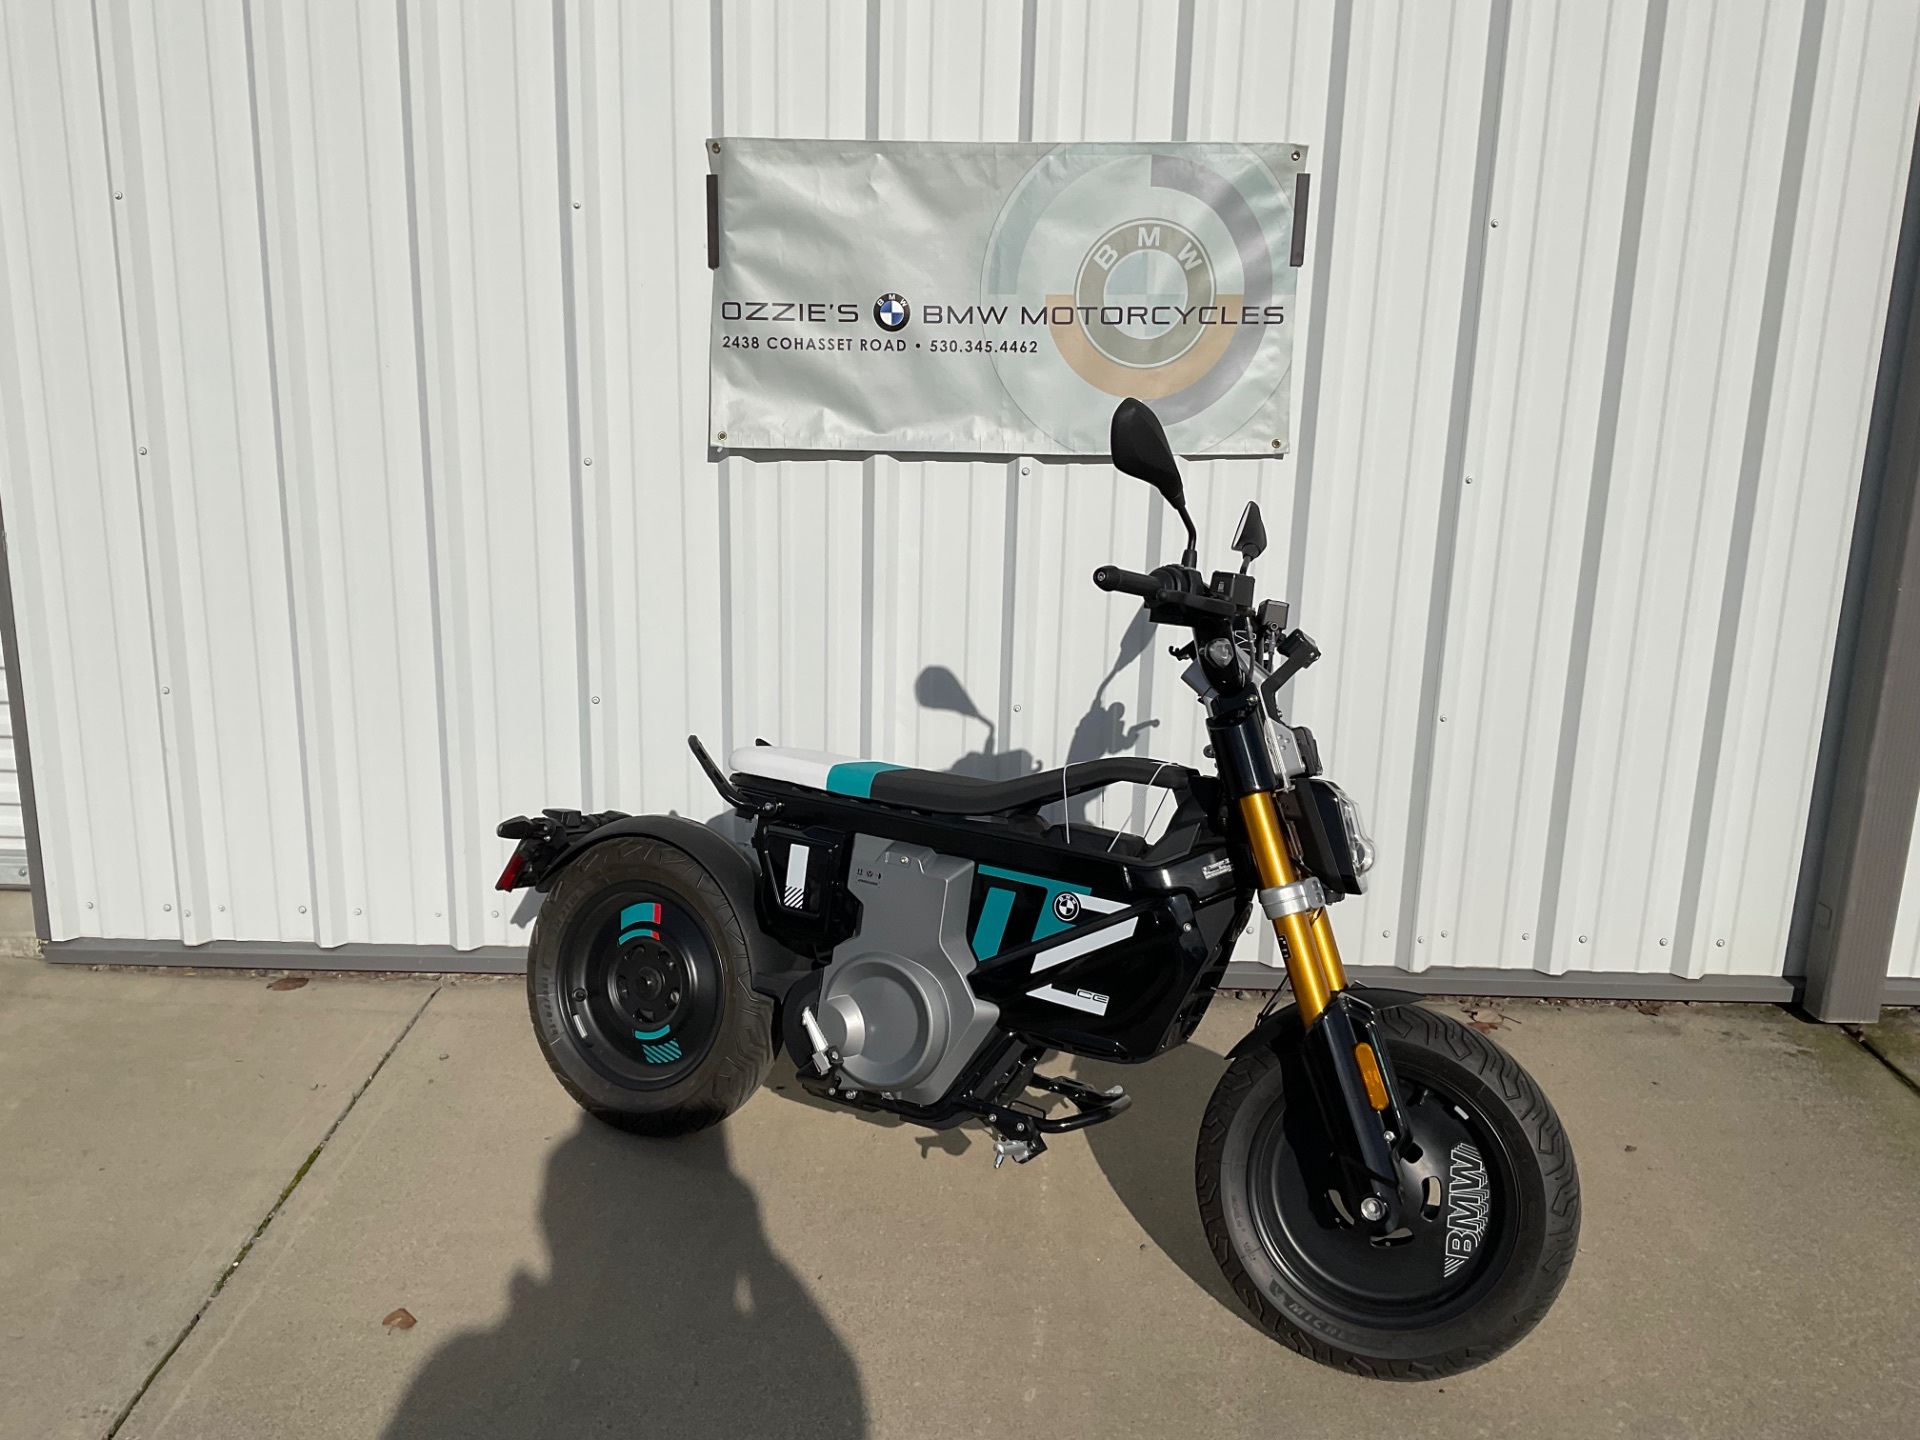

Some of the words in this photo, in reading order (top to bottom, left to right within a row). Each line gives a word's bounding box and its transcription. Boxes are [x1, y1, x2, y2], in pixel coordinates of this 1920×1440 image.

[1093, 226, 1203, 272] BMW
[876, 293, 908, 307] BMW
[721, 301, 859, 323] OZZIE'S
[923, 305, 1009, 325] BMW
[1020, 305, 1285, 326] MOTORCYCLES
[722, 335, 760, 349] 2438
[766, 336, 853, 351] COHASSET
[860, 338, 907, 352] ROAD
[929, 339, 1038, 354] 530.345.4462
[1445, 1143, 1487, 1259] BMW
